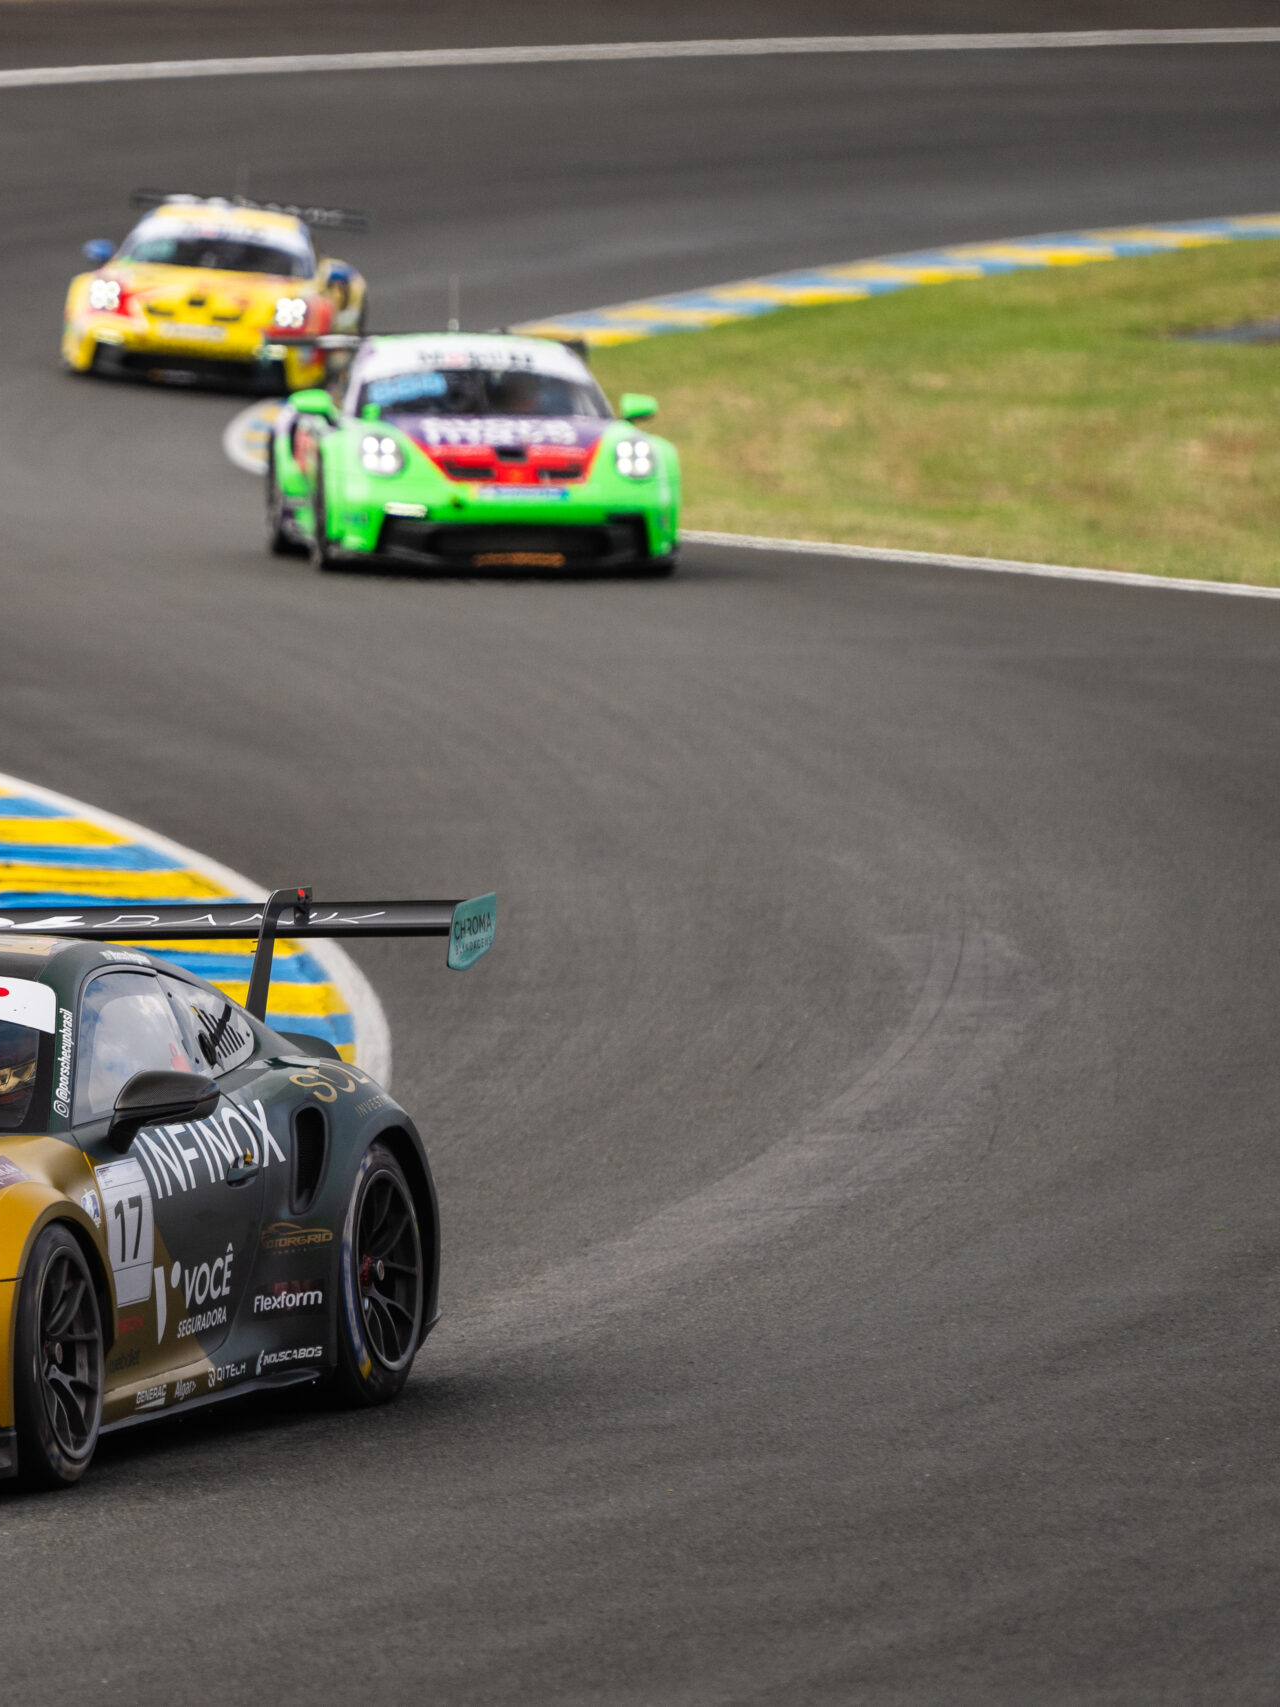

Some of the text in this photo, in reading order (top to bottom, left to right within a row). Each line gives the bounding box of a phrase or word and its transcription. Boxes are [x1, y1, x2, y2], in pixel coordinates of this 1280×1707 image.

[454, 911, 492, 941] CHROMA
[55, 1007, 75, 1103] @porschecupbrasil
[133, 1099, 287, 1200] INFINOX
[114, 1195, 143, 1264] 17
[184, 1242, 234, 1309] VOCÊ
[177, 1305, 227, 1339] SEGURADORA
[253, 1290, 323, 1313] Flexform
[135, 1383, 168, 1405] GENERAC
